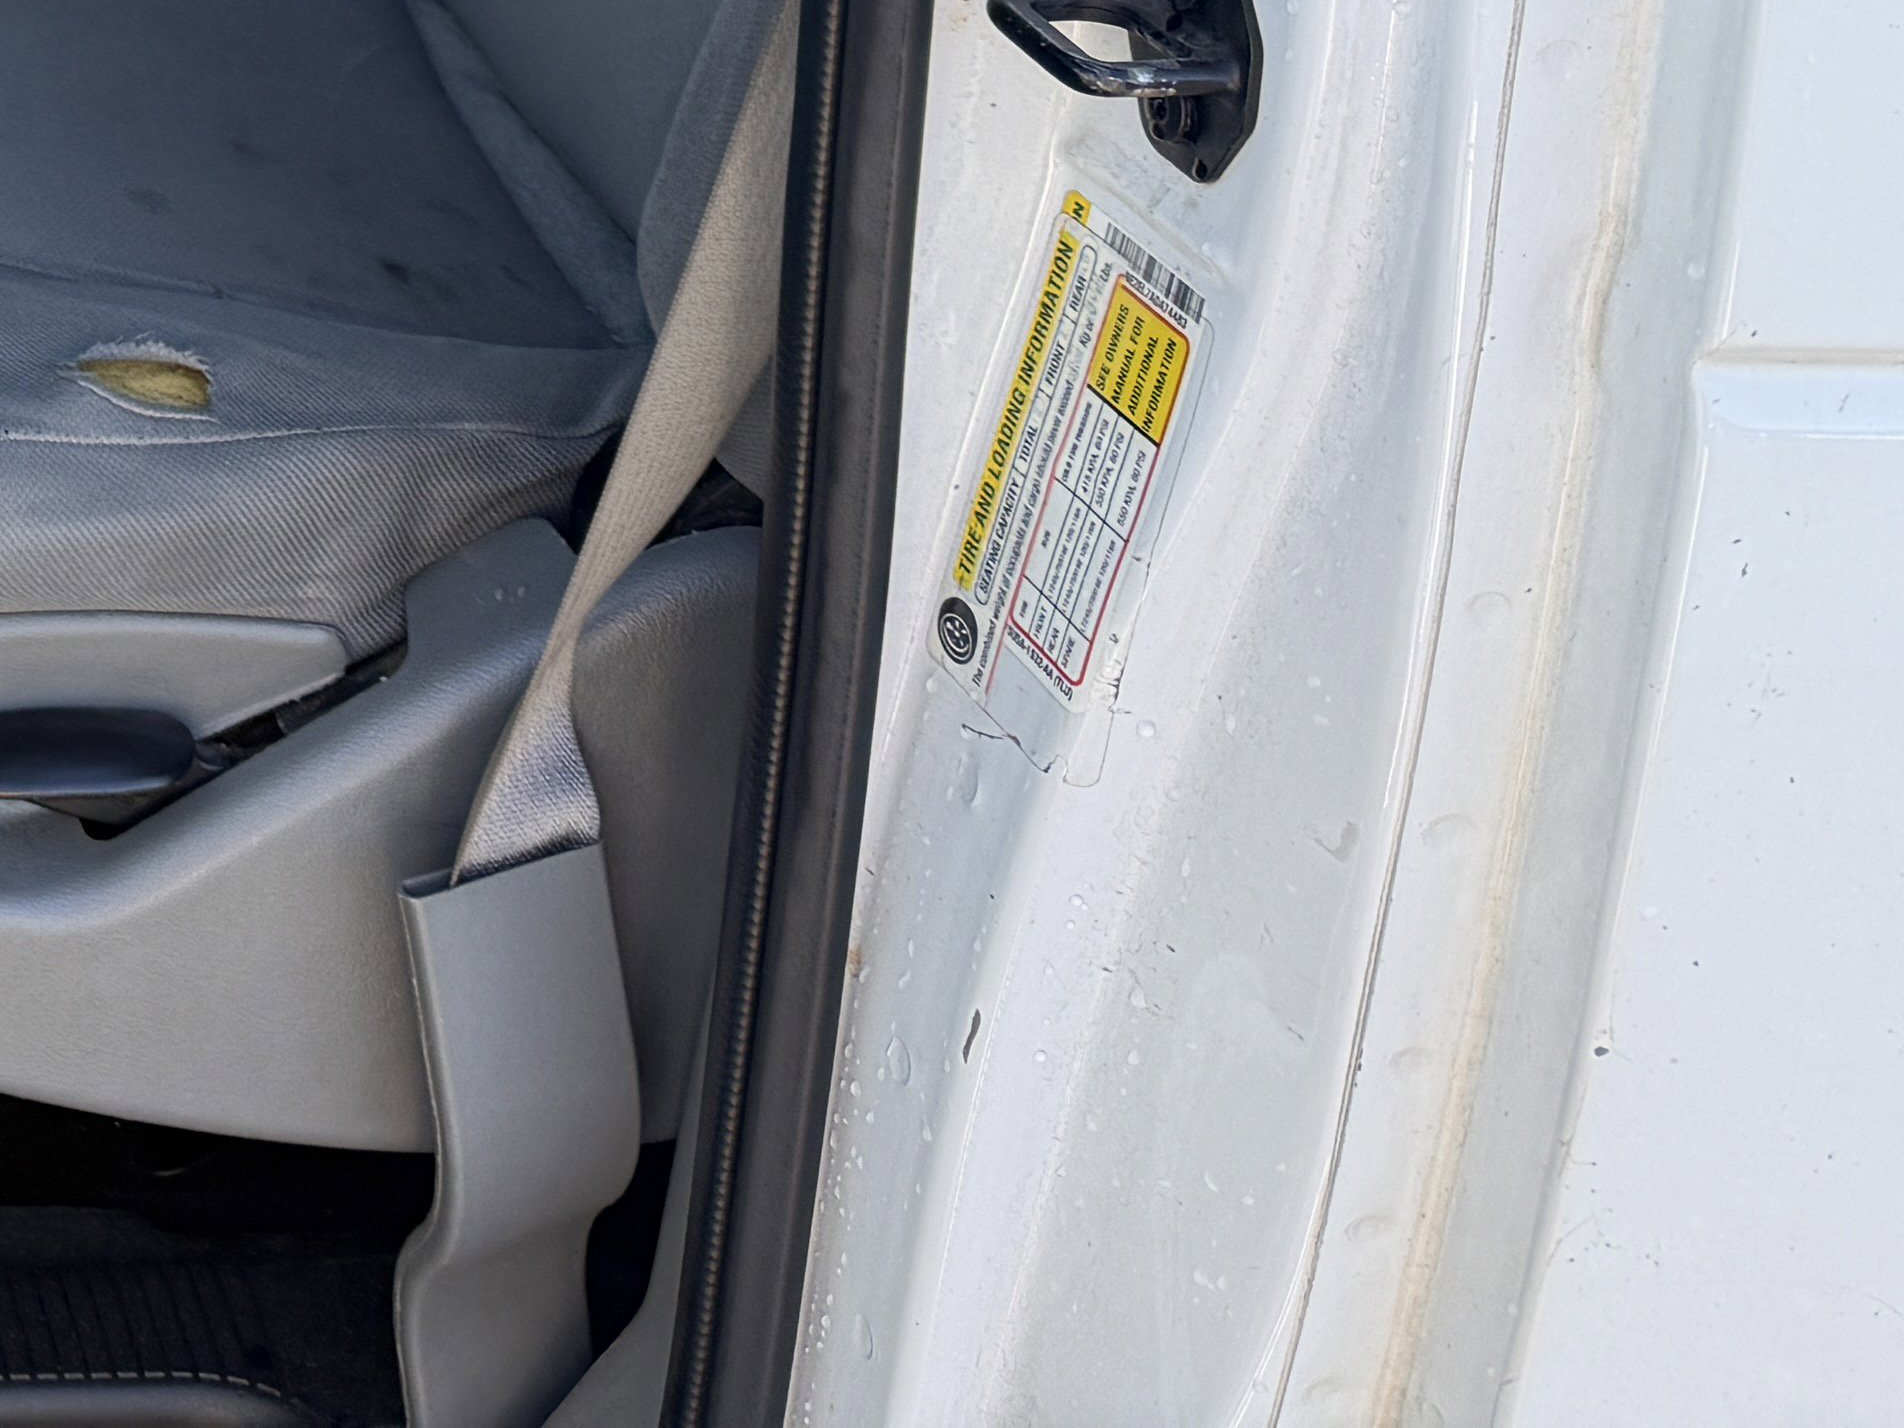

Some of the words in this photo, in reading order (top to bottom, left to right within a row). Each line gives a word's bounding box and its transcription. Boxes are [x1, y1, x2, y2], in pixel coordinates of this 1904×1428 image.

[1069, 275, 1087, 312] REAR
[1045, 341, 1065, 386] FRONT
[1096, 363, 1110, 391] SEE
[1105, 304, 1129, 362] OWNERS
[1111, 349, 1135, 404] MANUAL
[1130, 316, 1145, 345] FOR
[1128, 337, 1159, 416] ADDITIONAL
[1141, 338, 1177, 432] INFORMATION
[959, 526, 981, 574] TIRE
[974, 481, 995, 528] AND
[988, 387, 1026, 480] LOADING
[1018, 239, 1073, 386] INFORMATION
[1019, 425, 1038, 462] TOTAL
[979, 540, 1001, 594] SEATING
[996, 477, 1019, 540] CAPACITY
